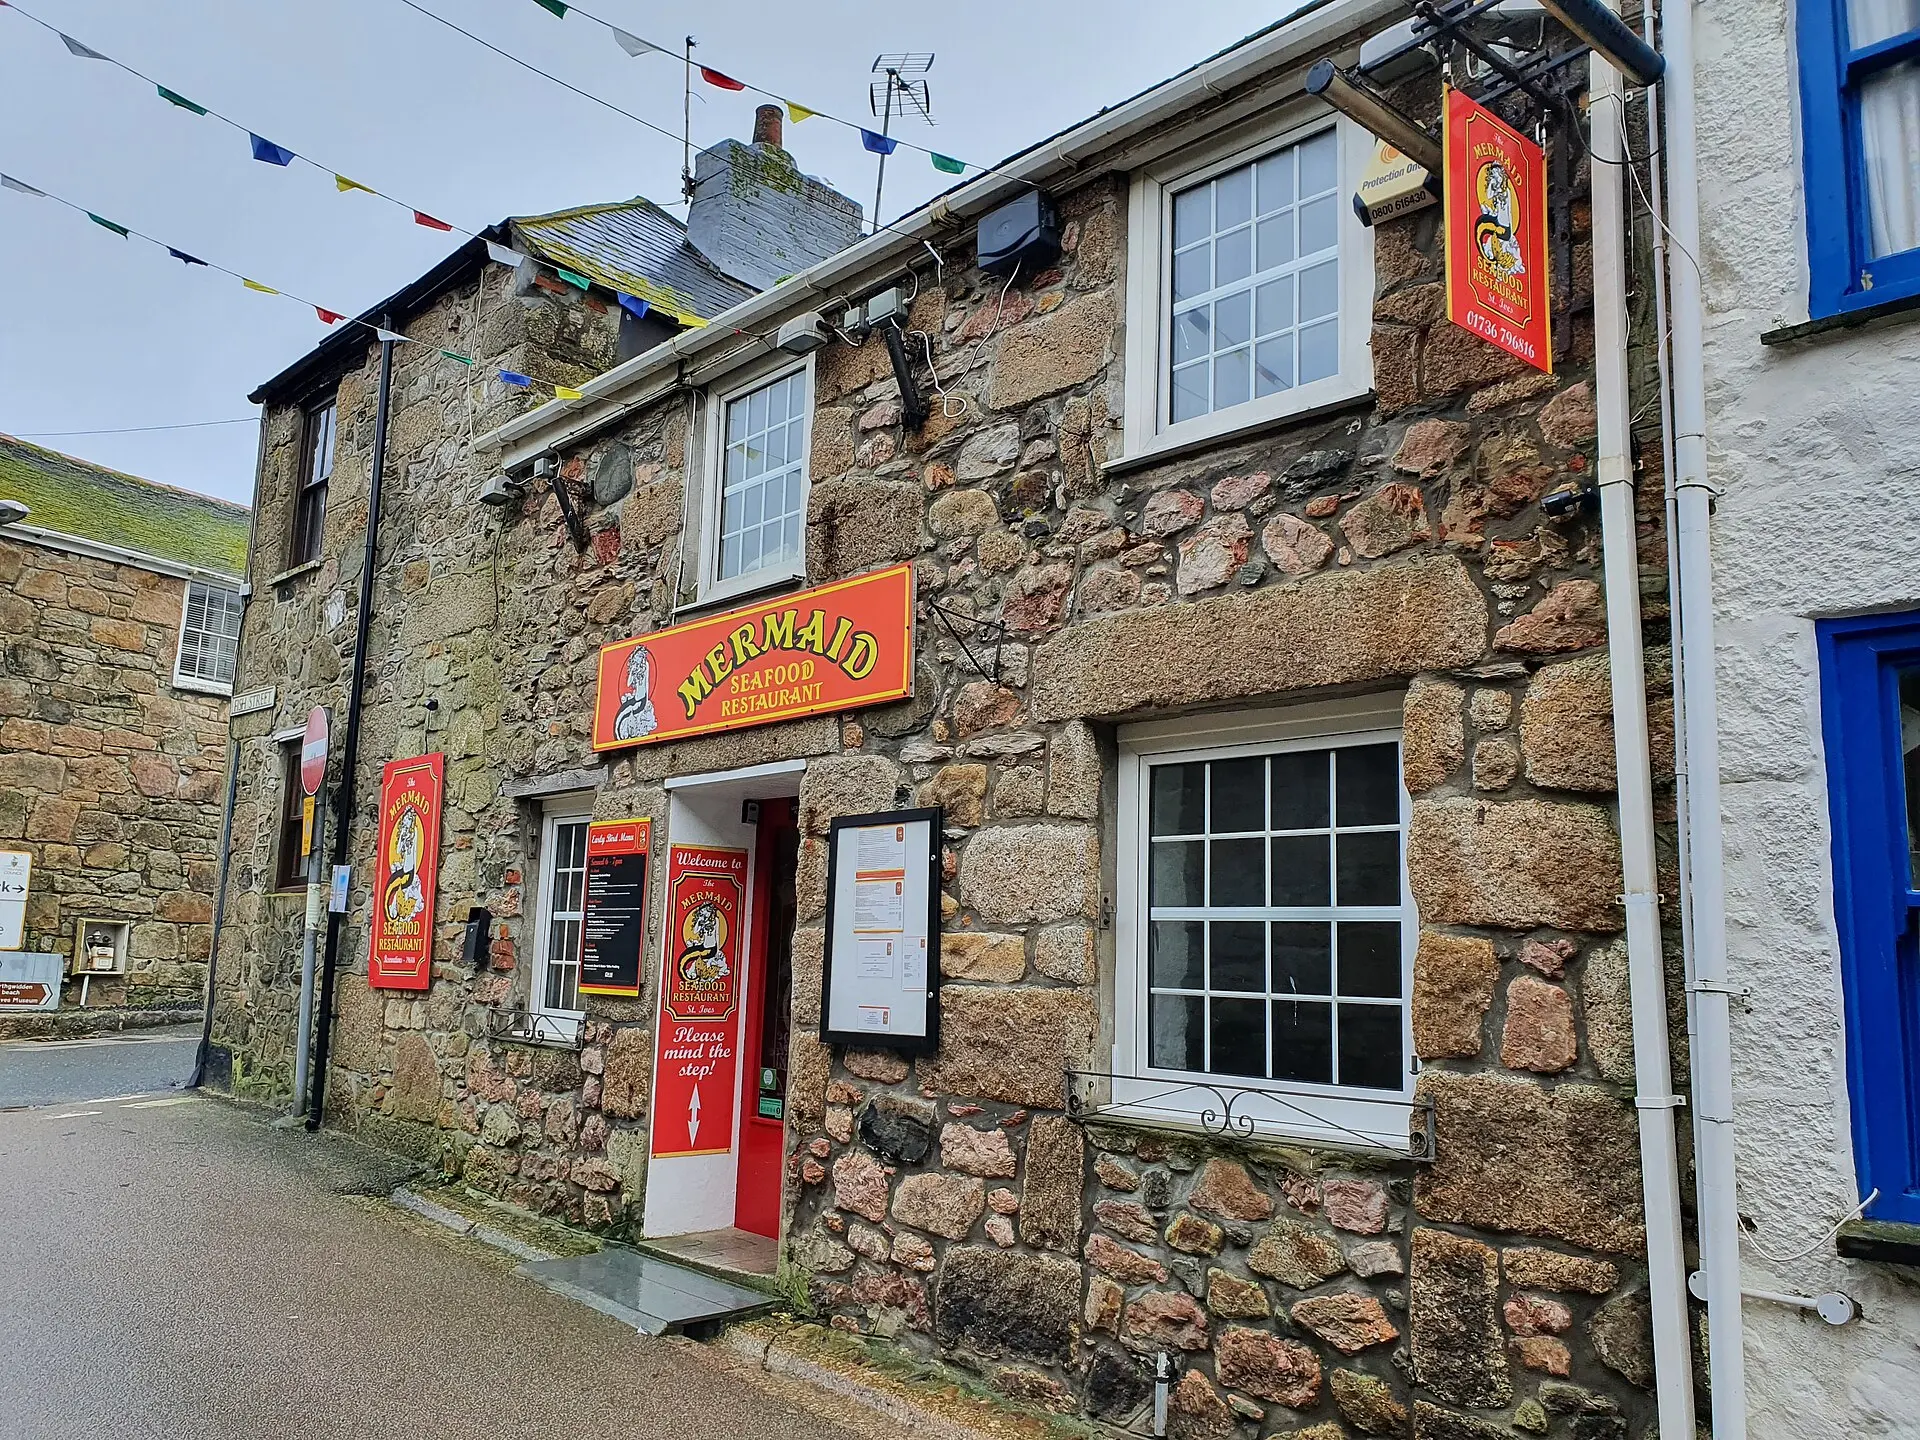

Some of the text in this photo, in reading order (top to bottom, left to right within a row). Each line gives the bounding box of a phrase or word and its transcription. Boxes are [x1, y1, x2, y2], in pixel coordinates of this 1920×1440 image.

[1473, 142, 1523, 187] MERMAID
[1361, 167, 1405, 191] Protection
[1371, 190, 1427, 219] 0800 616430
[1477, 255, 1523, 293] SEAFOOD
[1472, 267, 1528, 310] RESTAURANT
[1466, 310, 1535, 359] 01736 796816
[676, 608, 880, 721] MERMAID
[730, 659, 815, 695] SEAFOOD
[720, 681, 824, 717] RESTAURANT
[388, 790, 431, 822] MERMAID
[591, 834, 606, 846] Early
[676, 851, 742, 869] Welcome to
[702, 879, 716, 887] The
[680, 891, 733, 911] MERMAID
[382, 920, 420, 936] SEAFOOD
[378, 938, 423, 952] RESTAURANT
[678, 981, 726, 992] SEAFOOD
[672, 993, 730, 1002] RESTAURANT
[686, 1004, 715, 1014] St. Ives
[673, 1026, 725, 1043] Please
[663, 1042, 732, 1060] mind the
[678, 1059, 716, 1081] step!
